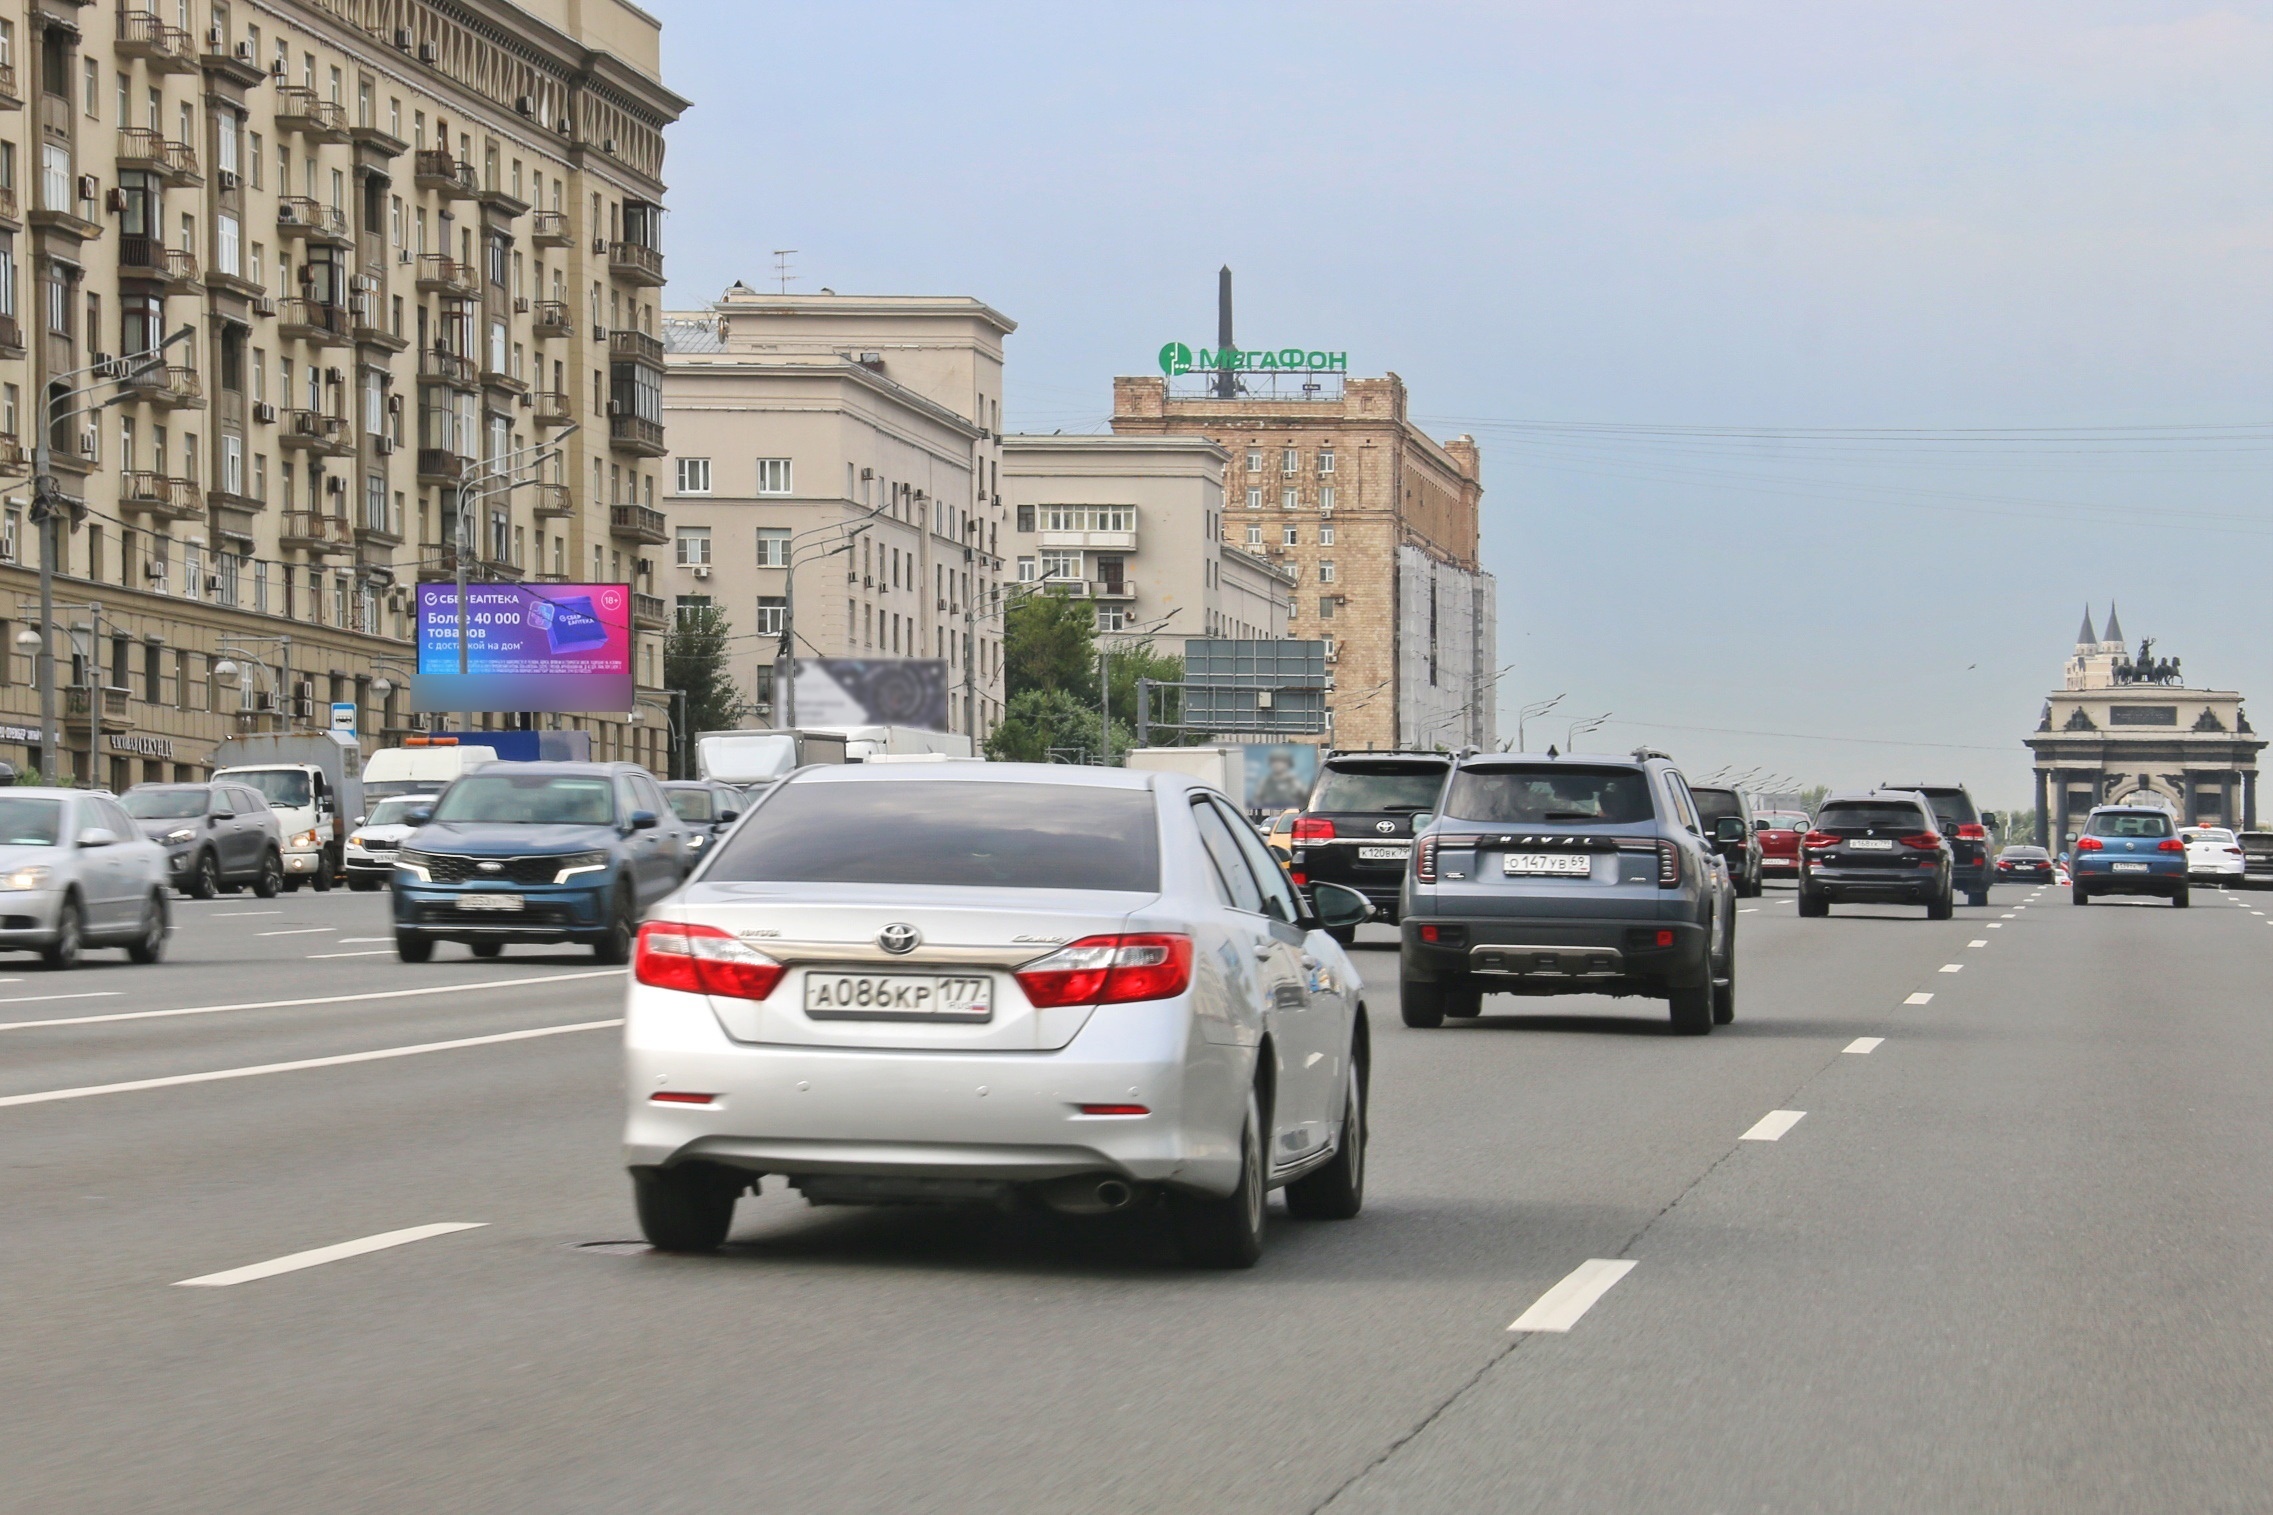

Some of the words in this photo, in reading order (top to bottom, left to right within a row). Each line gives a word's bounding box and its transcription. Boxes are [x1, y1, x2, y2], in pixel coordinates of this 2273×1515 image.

[604, 596, 619, 604] 18+
[474, 612, 492, 625] 40
[494, 612, 521, 625] 000
[428, 628, 486, 638] товаов
[487, 642, 499, 650] на
[138, 736, 174, 760] СЕКУНДА
